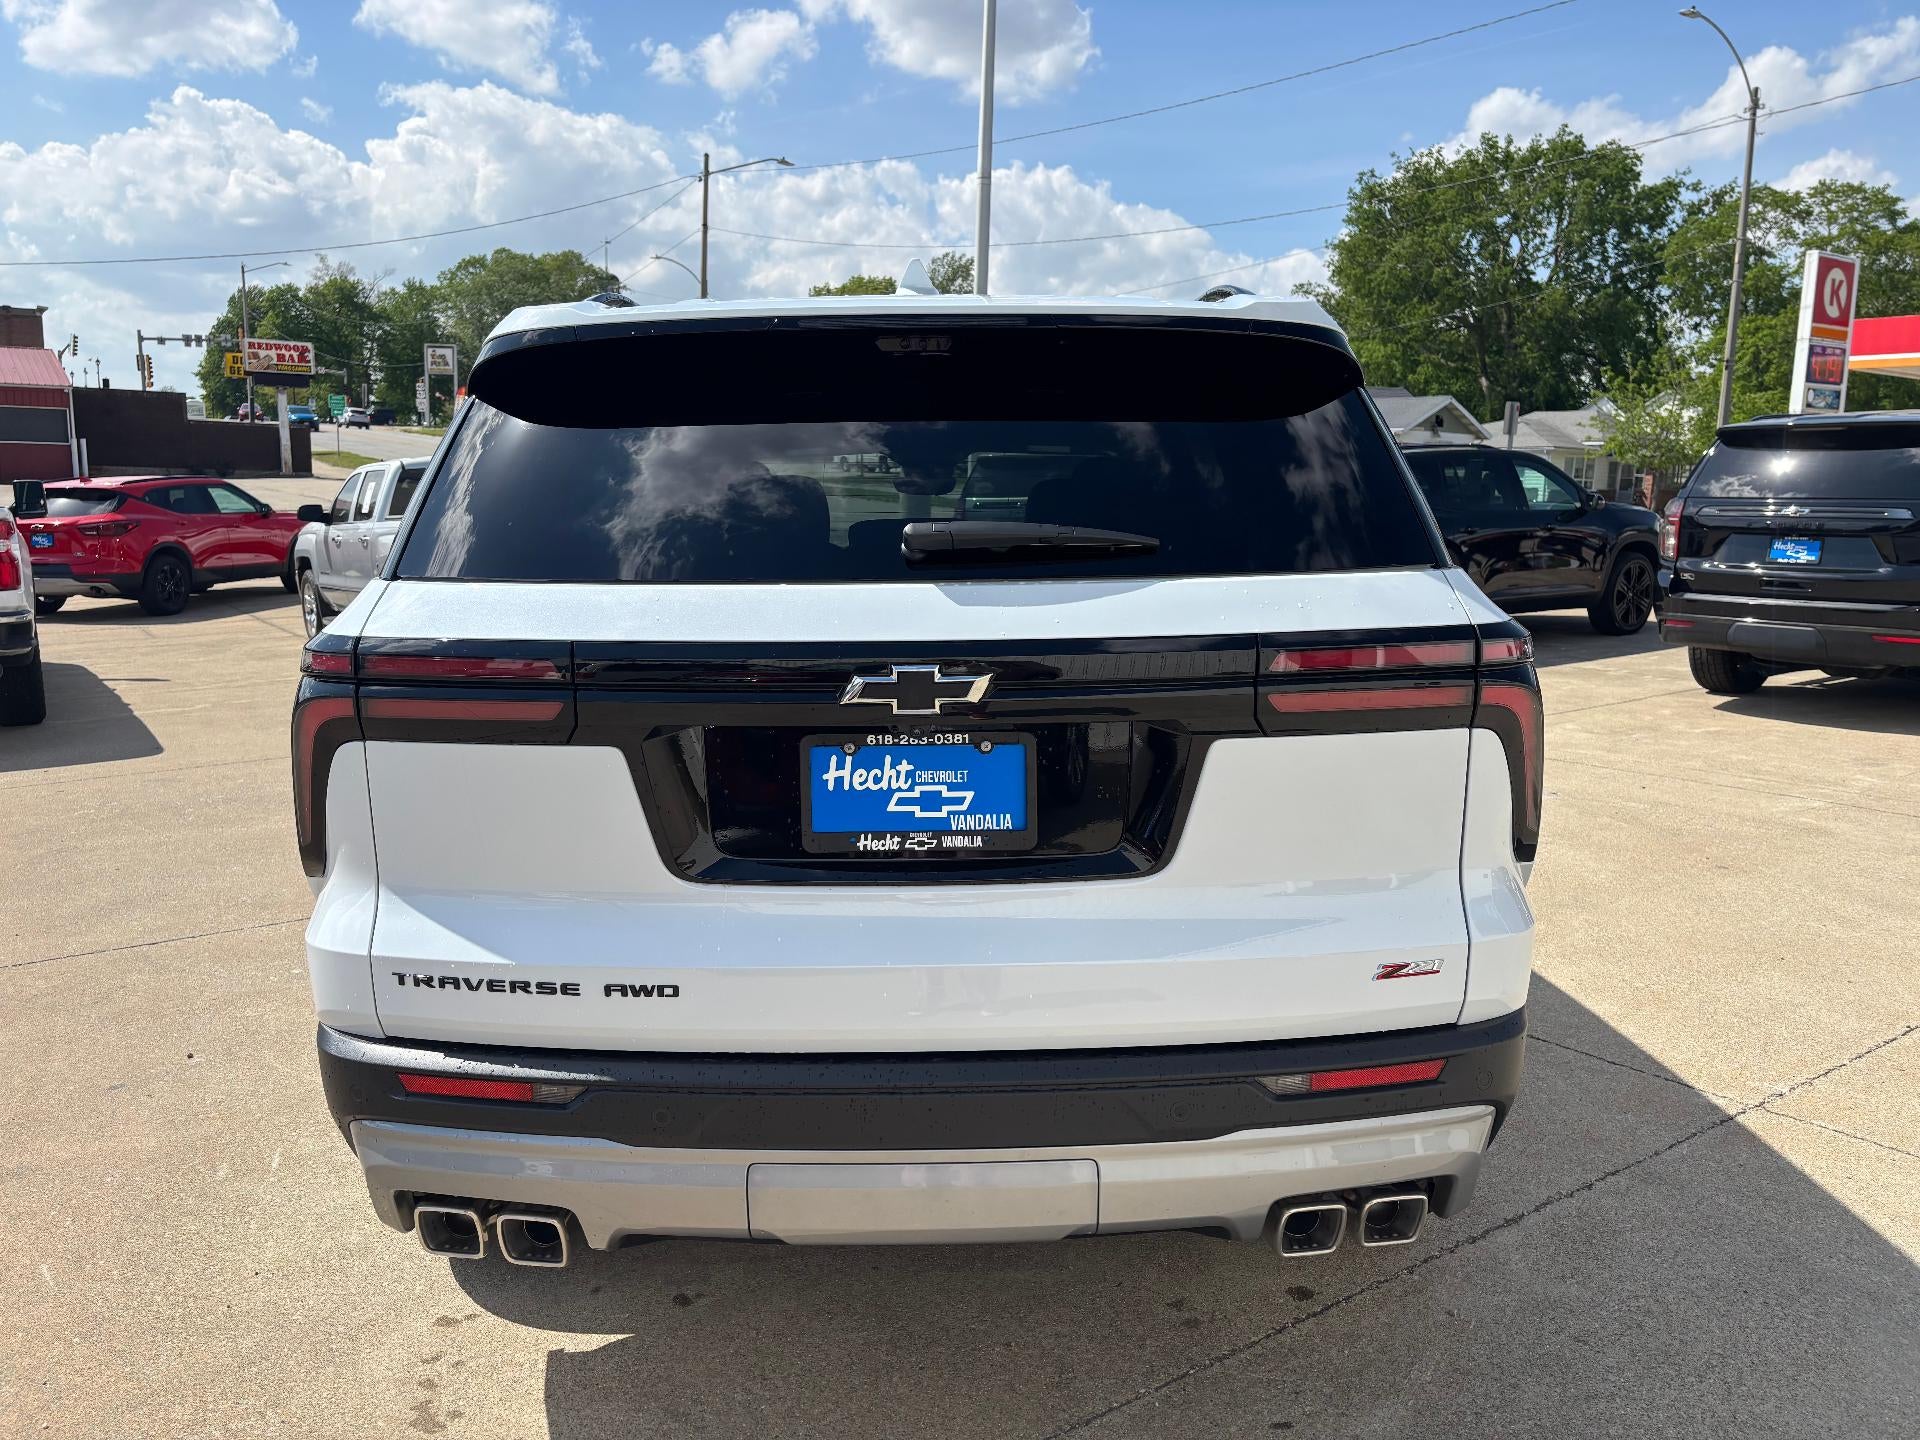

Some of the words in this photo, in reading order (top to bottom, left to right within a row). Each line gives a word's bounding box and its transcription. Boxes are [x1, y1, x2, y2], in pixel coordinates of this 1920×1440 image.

[247, 341, 311, 353] REDWOOD
[822, 754, 915, 791] Hecht
[915, 770, 969, 783] CHEVROLET
[950, 813, 1013, 831] VANDALIA
[857, 833, 902, 851] Hecht
[941, 835, 983, 848] VANDALIA
[391, 971, 581, 997] TRAVERSE
[604, 983, 680, 998] AWD
